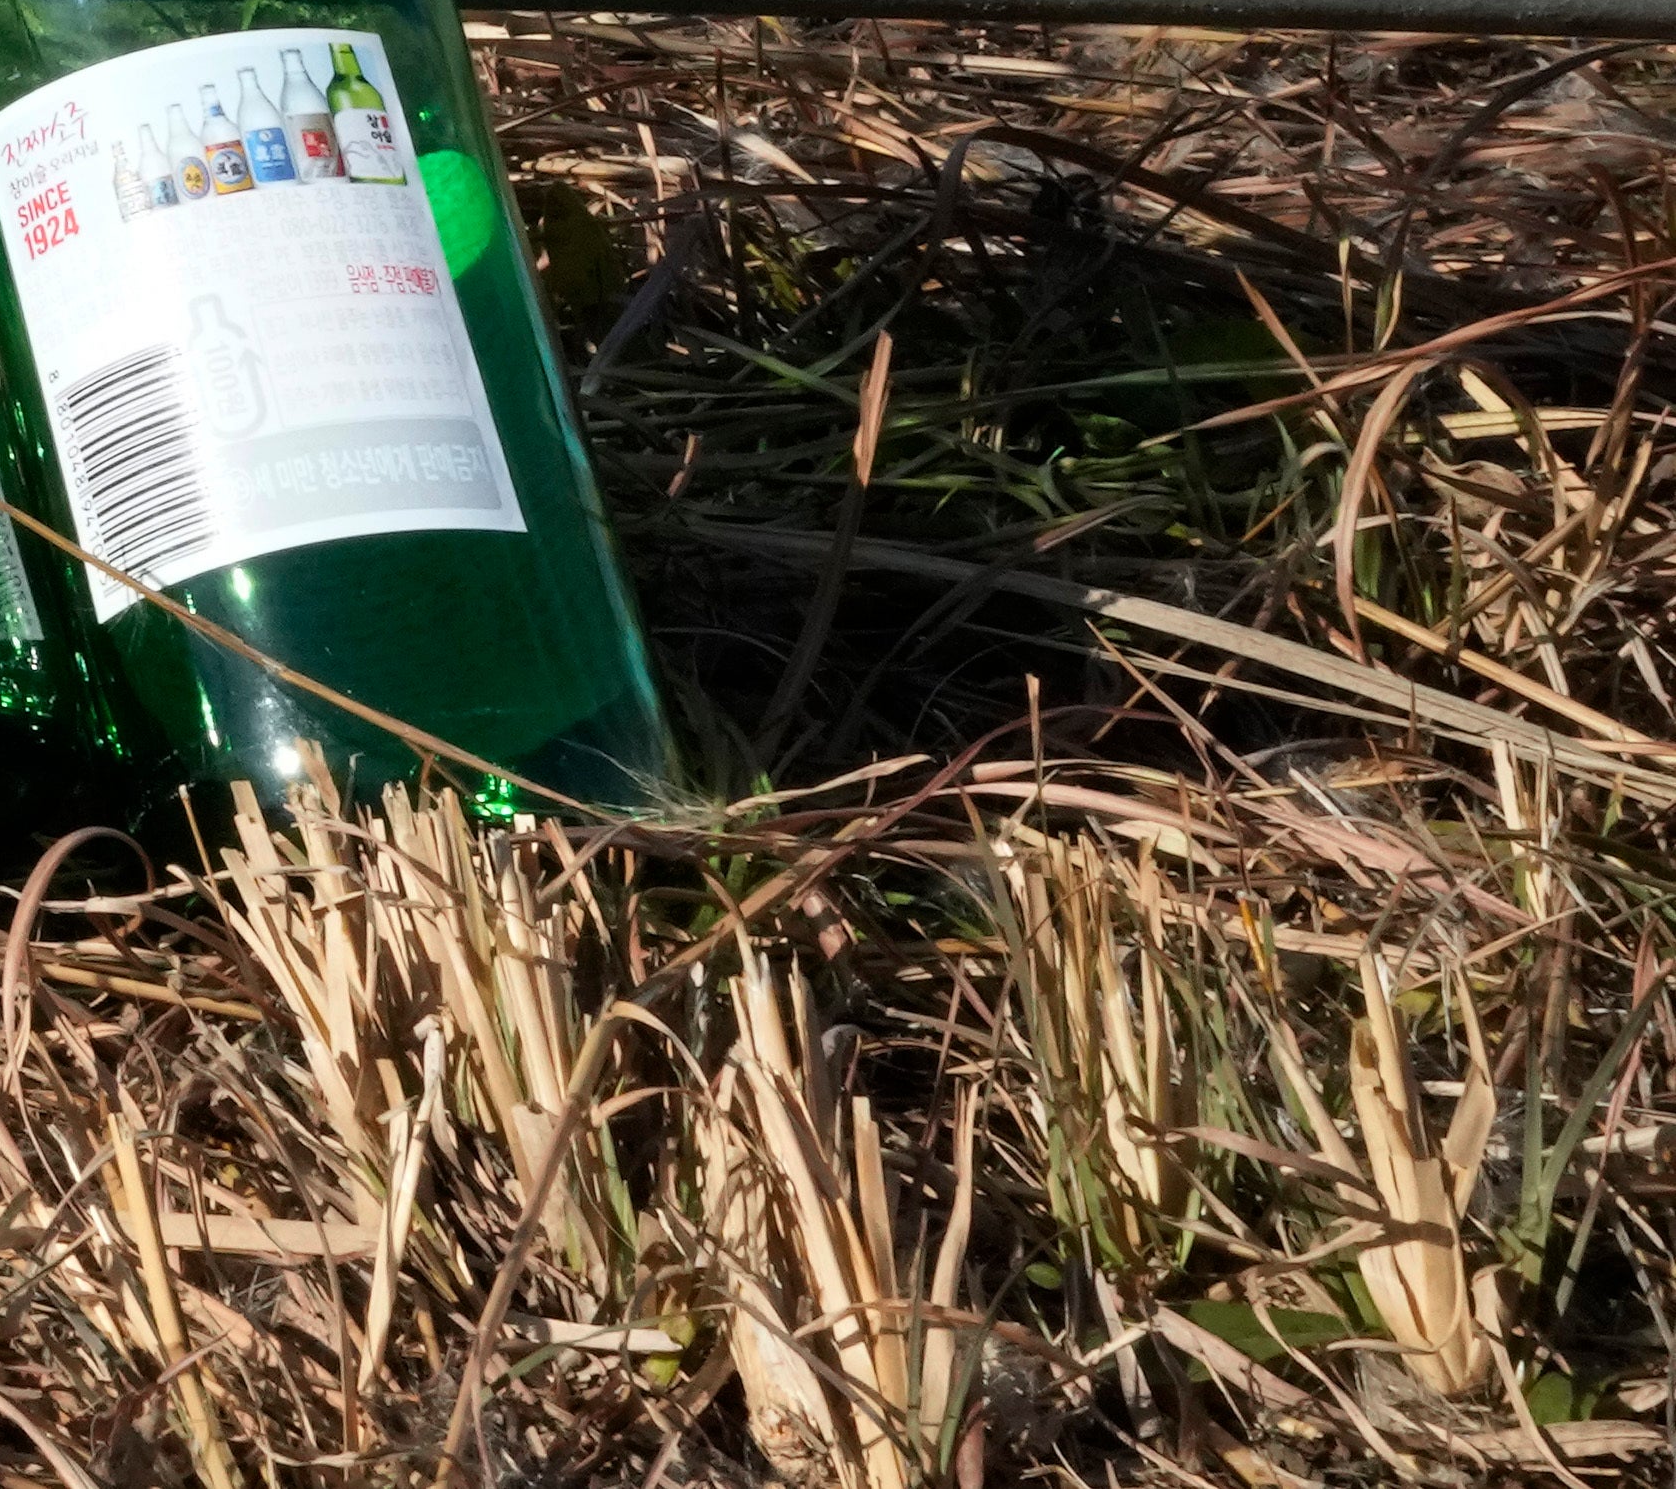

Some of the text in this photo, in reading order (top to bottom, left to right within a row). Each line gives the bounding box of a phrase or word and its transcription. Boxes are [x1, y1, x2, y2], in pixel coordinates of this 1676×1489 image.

[17, 180, 72, 228] SINCE
[24, 207, 80, 261] 1924
[276, 452, 319, 495] 미만
[318, 442, 418, 490] 청소년에게
